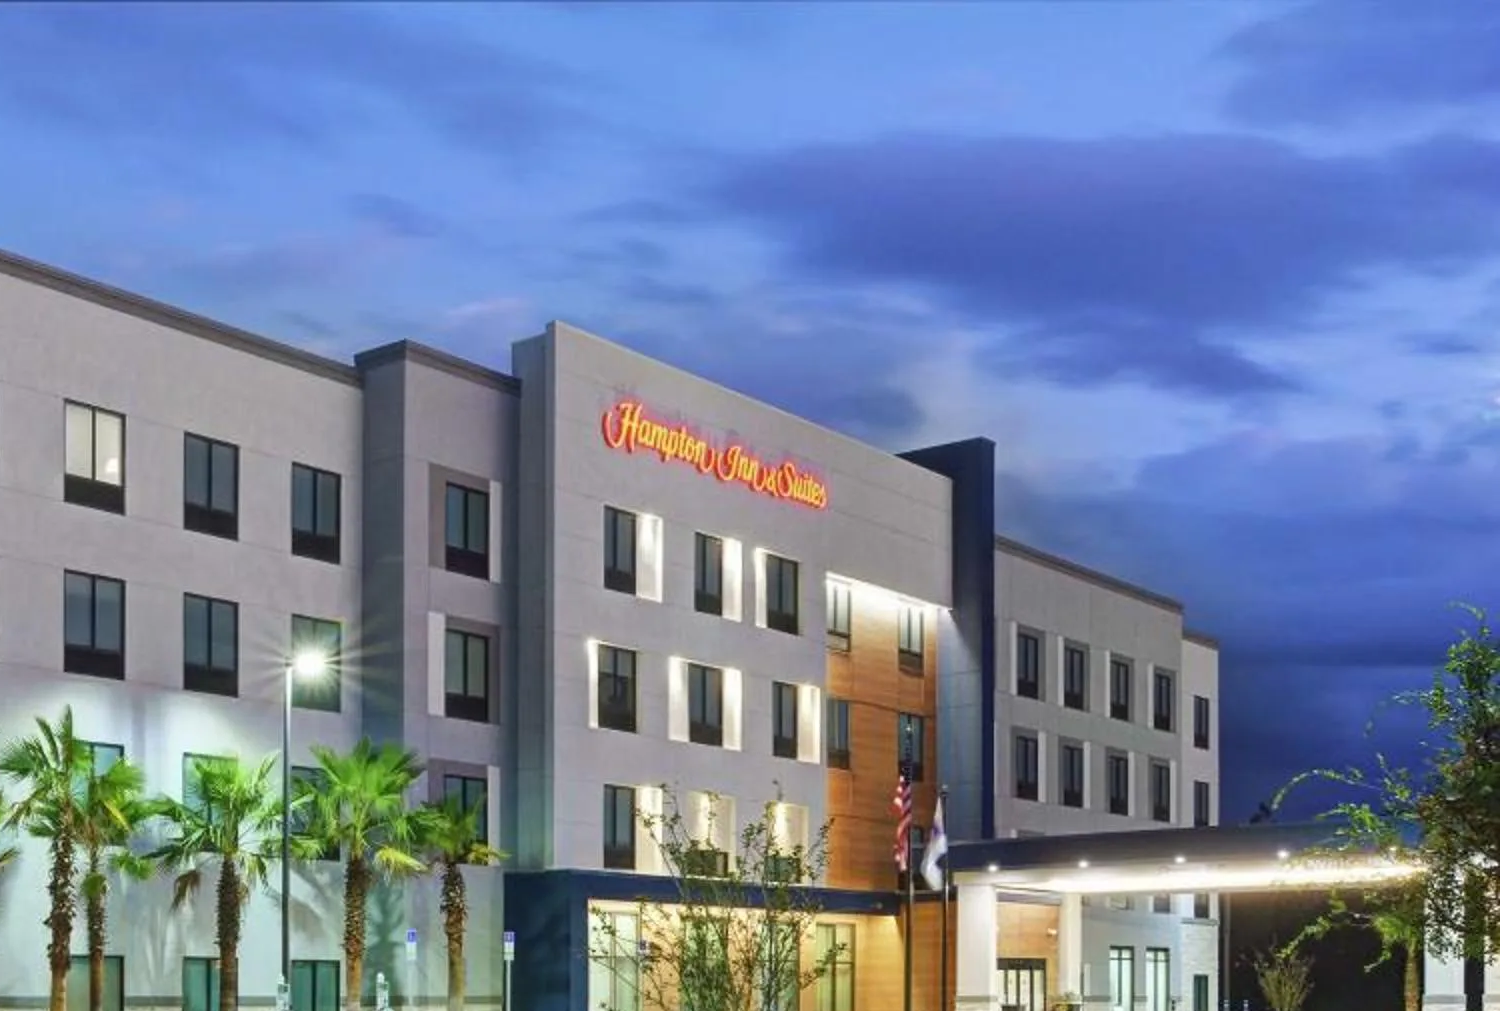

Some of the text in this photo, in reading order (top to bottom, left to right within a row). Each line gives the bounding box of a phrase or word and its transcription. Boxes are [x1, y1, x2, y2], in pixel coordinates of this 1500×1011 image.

[603, 402, 715, 474] Hampton
[716, 446, 767, 492] Inn
[776, 462, 828, 509] Suites
